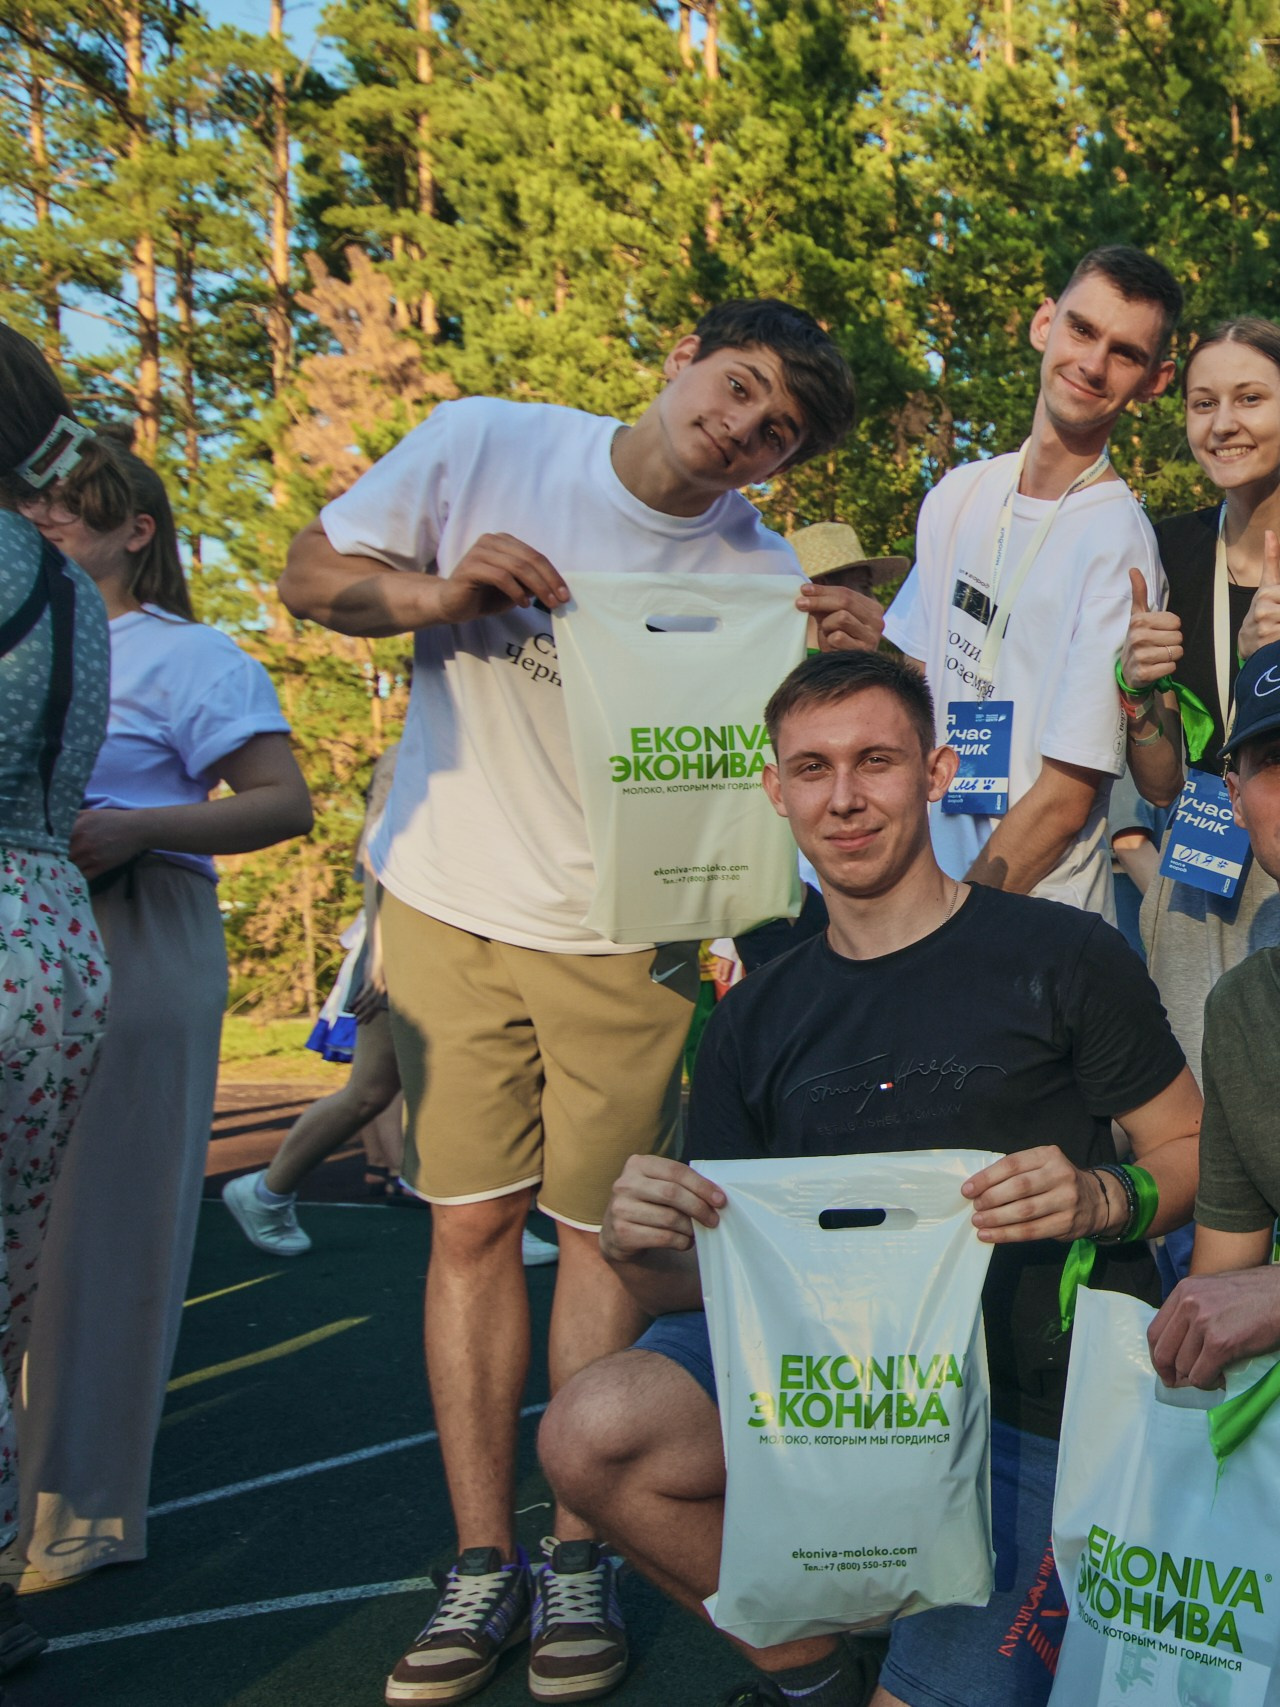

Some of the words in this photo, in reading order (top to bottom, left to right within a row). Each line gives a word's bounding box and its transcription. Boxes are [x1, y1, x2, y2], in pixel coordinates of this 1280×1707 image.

[947, 630, 982, 663] оли
[506, 642, 563, 687] Черн
[949, 744, 991, 755] ник
[609, 752, 766, 782] ЭКОНИВА
[622, 786, 665, 795] МОЛОКО,
[667, 784, 709, 793] КОТОРЫМ
[727, 783, 763, 791] ГОРДИМ
[1184, 781, 1197, 793] Я
[1179, 795, 1233, 820] учас
[1176, 809, 1230, 835] тник
[653, 864, 749, 876] ekoniva-moloko.com
[747, 1391, 950, 1429] ЭКОНИВА
[759, 1435, 812, 1446] МОЛОКО,
[814, 1434, 867, 1445] КОТОРЫМ
[870, 1434, 889, 1445] МЫ
[891, 1433, 950, 1446] ГОРДИМСЯ
[792, 1546, 918, 1559] ekoniva-moloko.com
[837, 1562, 860, 1572] (800)
[862, 1560, 907, 1569] 550-57-00
[1102, 1625, 1157, 1650] КОТОРЫМ
[1159, 1641, 1177, 1655] МЫ
[1181, 1648, 1242, 1672] ГОРДИМСЯ
